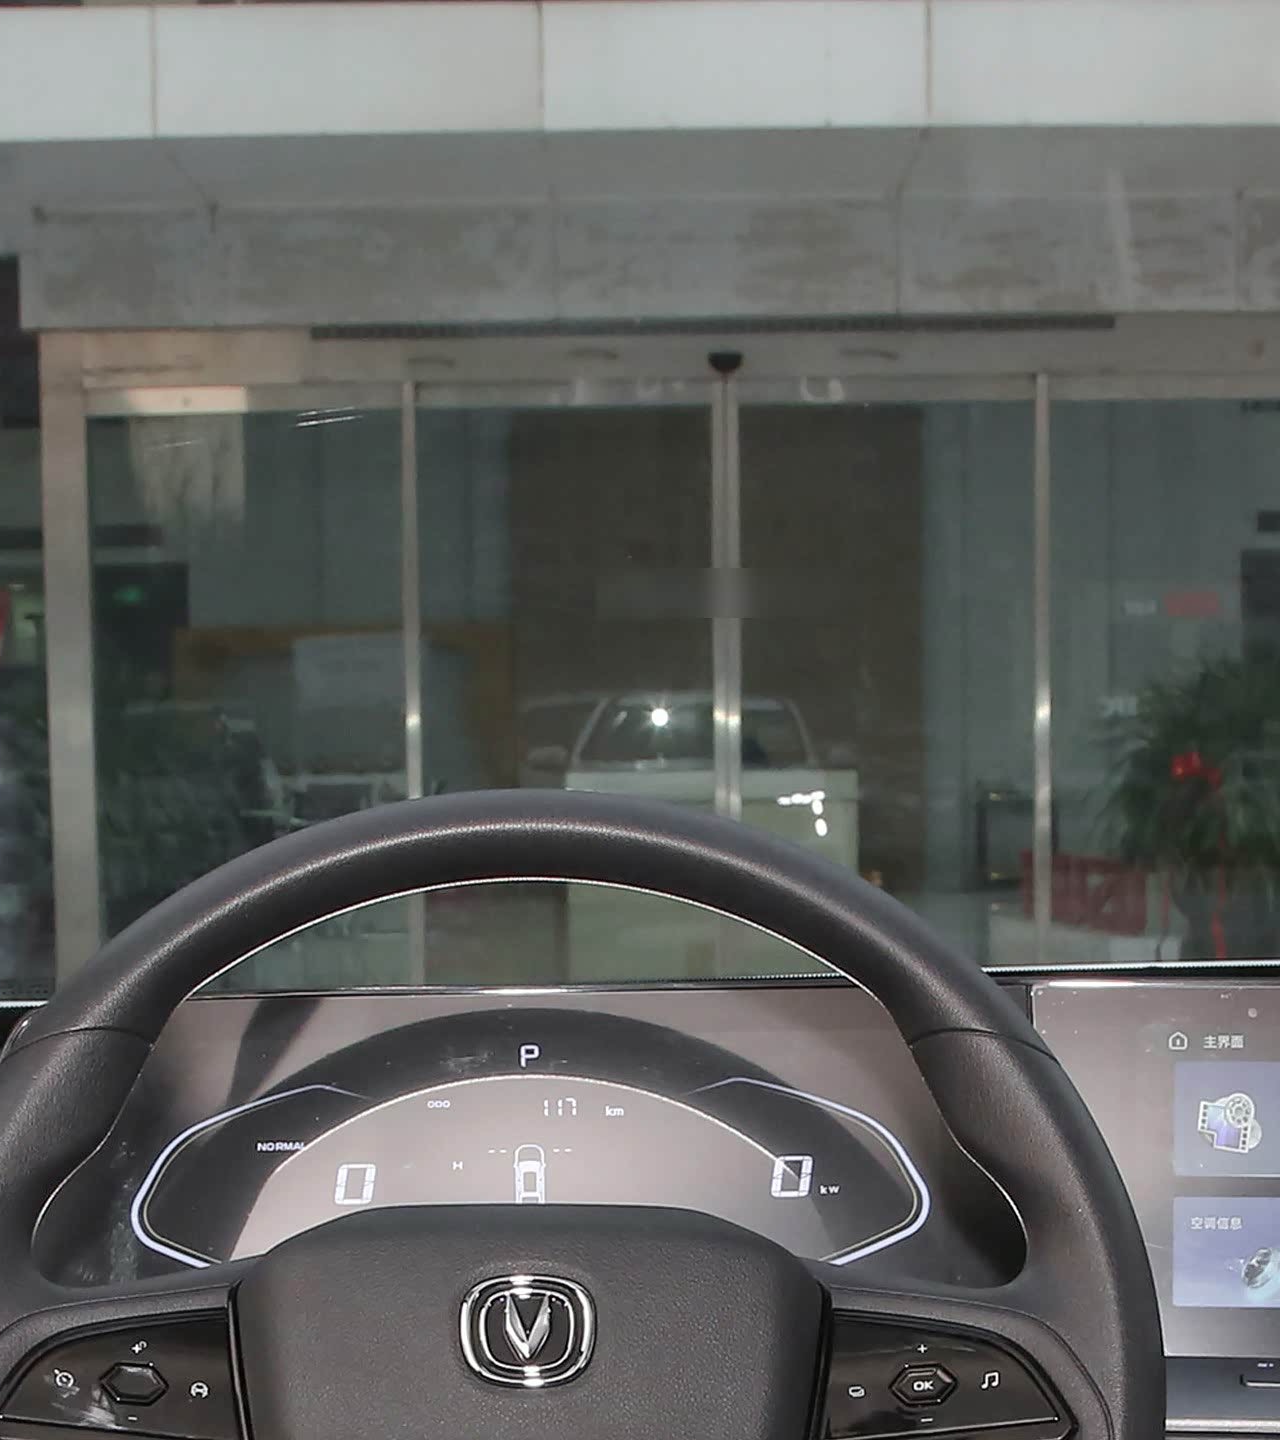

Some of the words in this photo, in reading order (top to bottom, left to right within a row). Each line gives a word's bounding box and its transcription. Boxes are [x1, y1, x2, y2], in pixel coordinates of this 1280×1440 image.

[1203, 1035, 1245, 1049] 主界面
[520, 1044, 540, 1067] P
[544, 1098, 577, 1116] 117
[605, 1105, 624, 1116] km
[257, 1142, 305, 1151] NORMAL
[334, 1163, 376, 1205] 0
[771, 1155, 813, 1197] 0
[1190, 1216, 1243, 1230] 空调信息
[913, 1380, 934, 1391] OK
